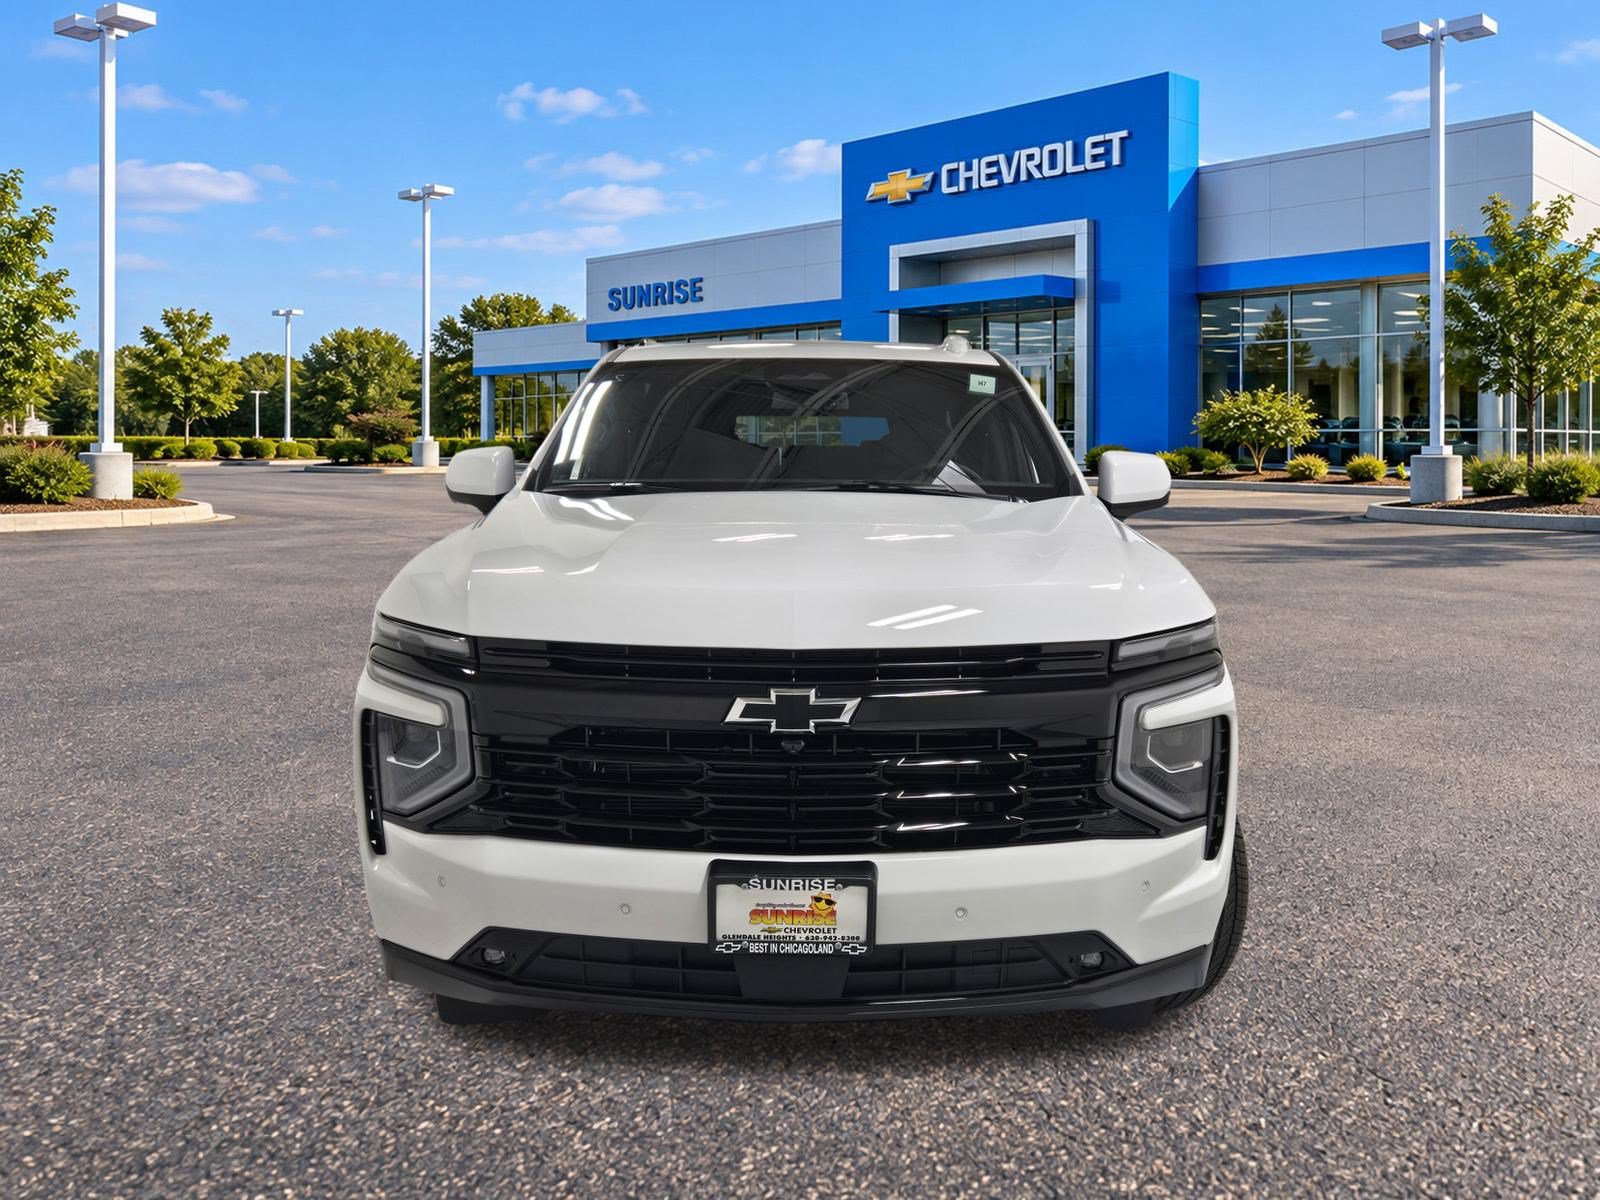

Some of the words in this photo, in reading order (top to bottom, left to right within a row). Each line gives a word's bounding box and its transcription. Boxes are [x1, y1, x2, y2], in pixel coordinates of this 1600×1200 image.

[940, 130, 1129, 194] CHEVROLET
[608, 277, 704, 312] SUNRISE
[749, 878, 836, 891] SUNRISE
[749, 909, 837, 925] SUNRISE
[749, 942, 768, 953] BEST
[769, 943, 778, 953] IN
[779, 943, 834, 954] CHICAGOLAND
